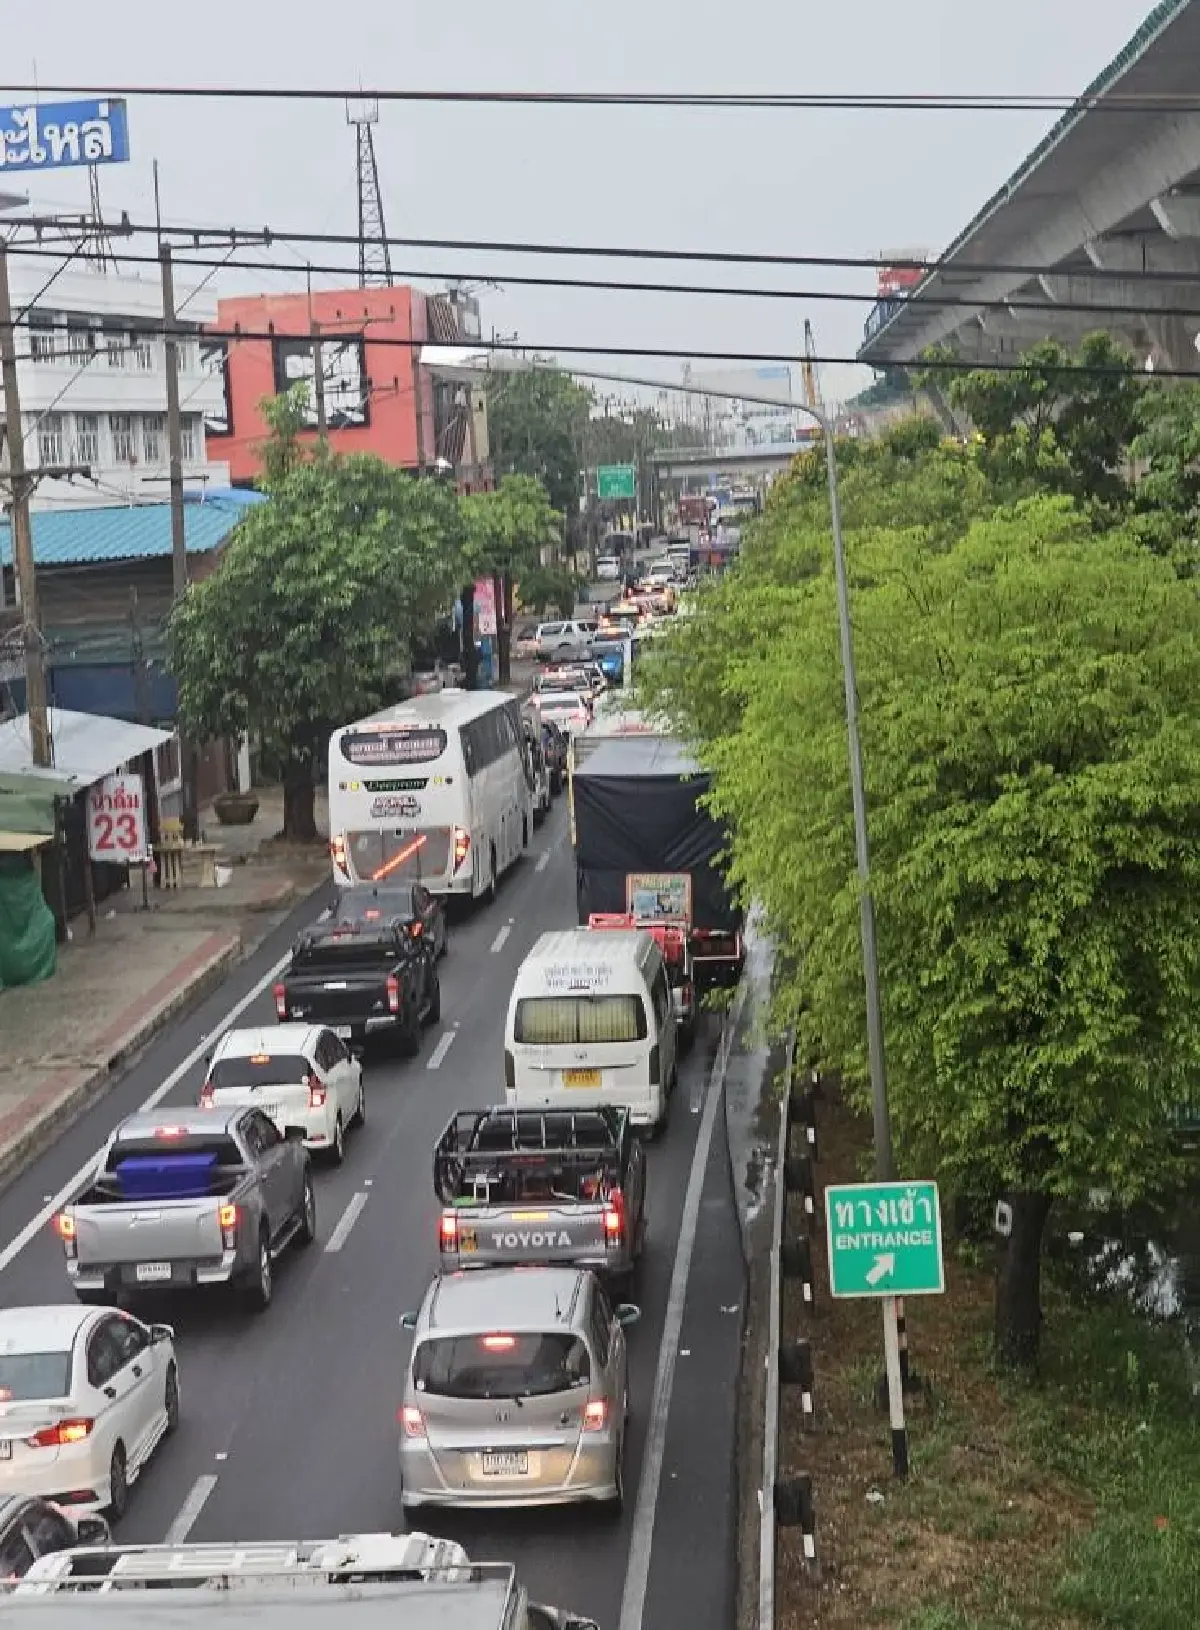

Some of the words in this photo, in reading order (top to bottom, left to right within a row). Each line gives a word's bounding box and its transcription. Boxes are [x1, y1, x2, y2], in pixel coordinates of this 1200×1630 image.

[0, 102, 112, 166] ะไหล่
[95, 813, 138, 851] 23
[835, 1187, 932, 1228] ทางเข้า
[491, 1231, 572, 1249] TOYOTA
[836, 1230, 932, 1250] ENTRANCE
